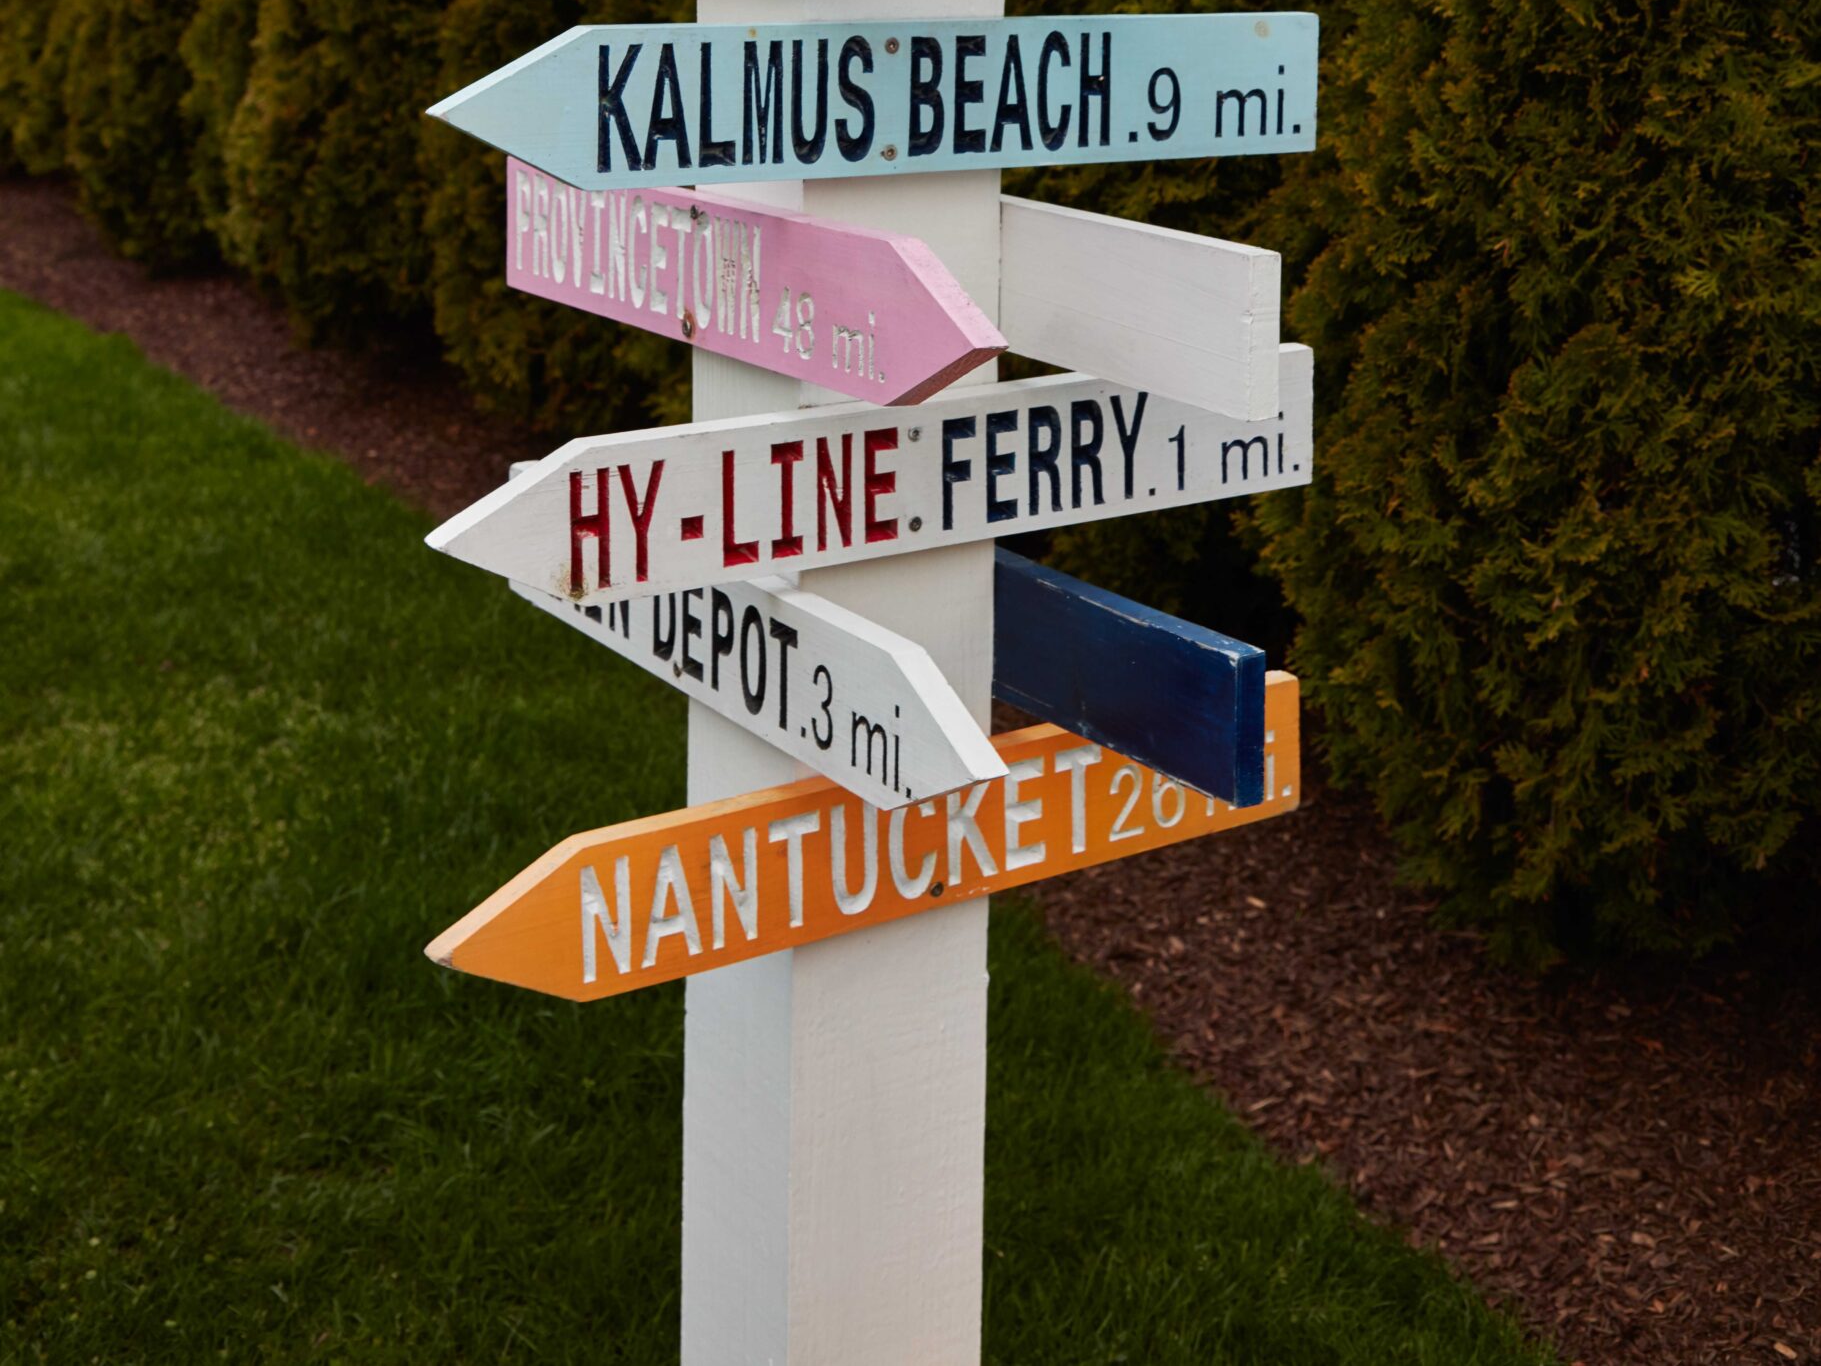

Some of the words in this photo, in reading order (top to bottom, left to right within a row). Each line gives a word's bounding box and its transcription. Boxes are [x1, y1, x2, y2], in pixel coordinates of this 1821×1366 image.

[598, 35, 874, 173] KALMUS
[907, 31, 1112, 157] BEACH
[1214, 65, 1301, 137] mi.
[515, 169, 763, 344] PROVINCETOWN
[772, 286, 816, 360] 48
[831, 310, 886, 384] mi.
[568, 427, 899, 596] HY-LINE
[941, 391, 1148, 531] FERRY
[1221, 410, 1300, 484] mi.
[652, 585, 799, 732] DEPOT
[850, 704, 913, 800] mi.
[579, 744, 1103, 983] NANTUCKET
[1108, 763, 1187, 843] 26
[1205, 730, 1293, 817] i.
